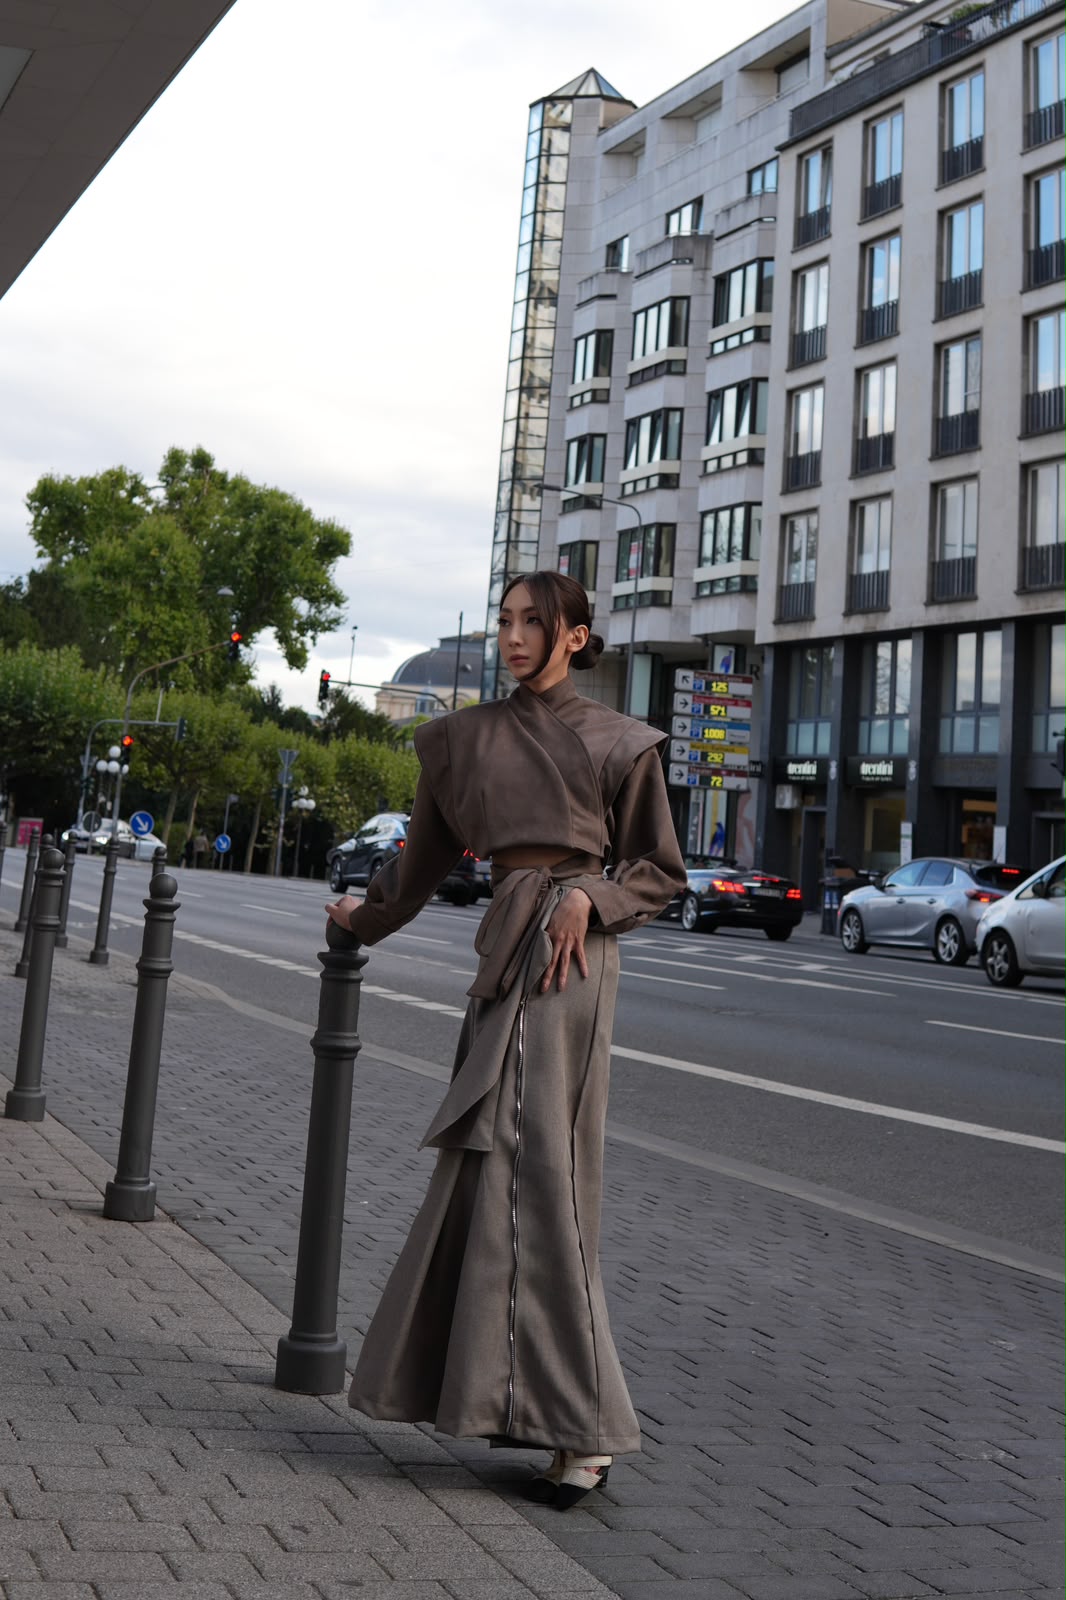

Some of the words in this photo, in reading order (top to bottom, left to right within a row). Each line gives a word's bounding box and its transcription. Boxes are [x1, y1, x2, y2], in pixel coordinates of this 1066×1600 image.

[711, 681, 728, 693] 125
[710, 705, 726, 716] 571
[703, 728, 726, 739] 1008
[707, 752, 724, 764] 292
[787, 760, 817, 775] trentini
[860, 760, 893, 776] trentini
[711, 775, 723, 787] 72
